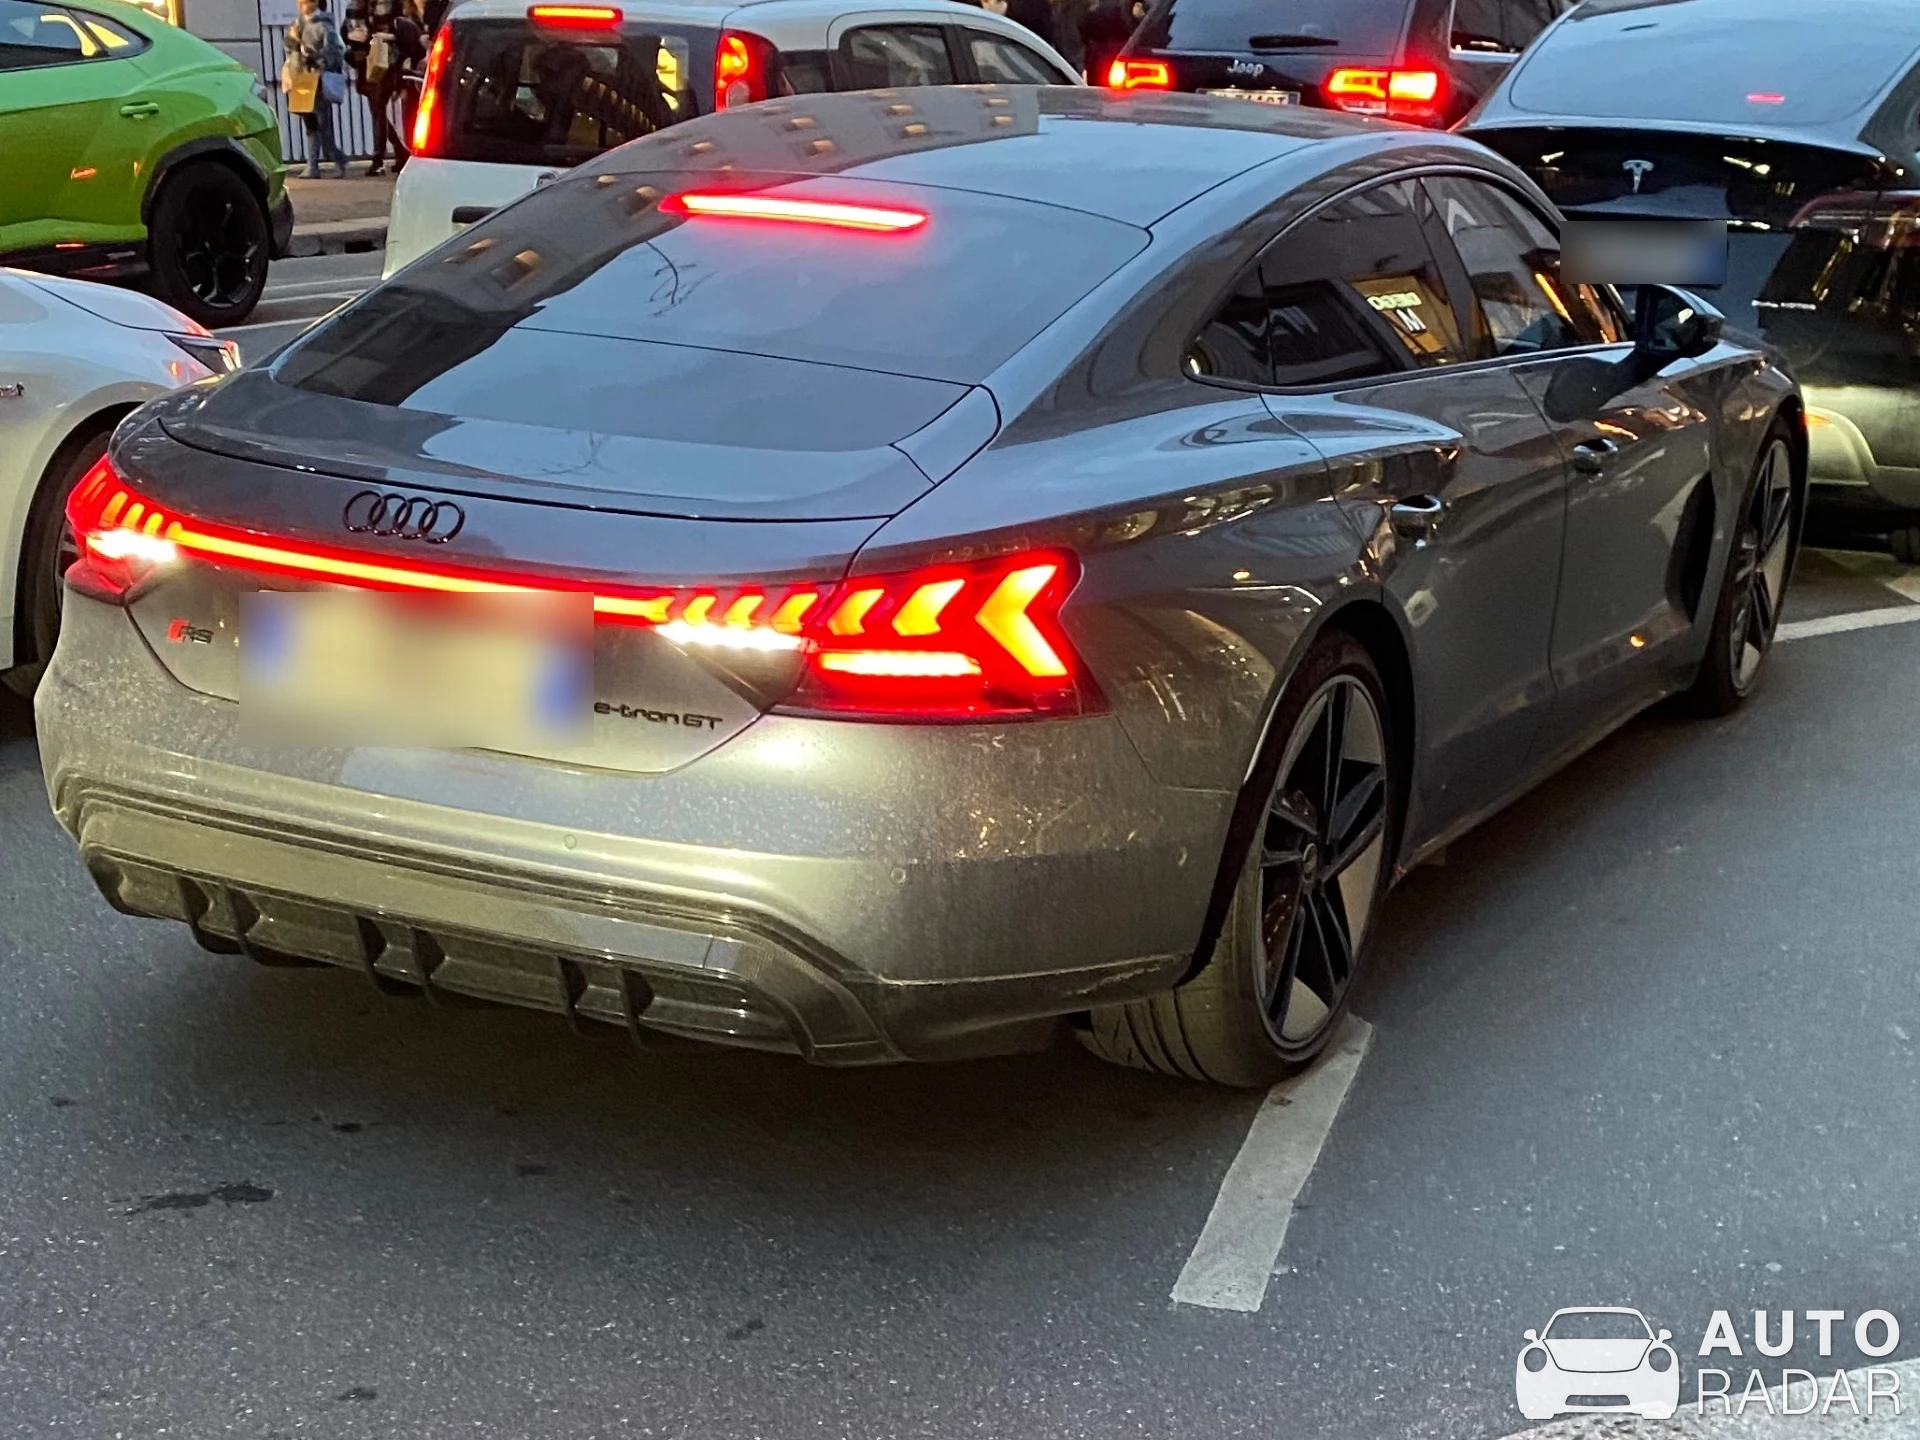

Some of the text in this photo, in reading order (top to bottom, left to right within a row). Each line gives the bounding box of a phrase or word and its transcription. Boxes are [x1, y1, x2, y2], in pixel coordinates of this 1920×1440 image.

[1227, 59, 1264, 77] Jeep
[593, 702, 723, 730] e-tron GT
